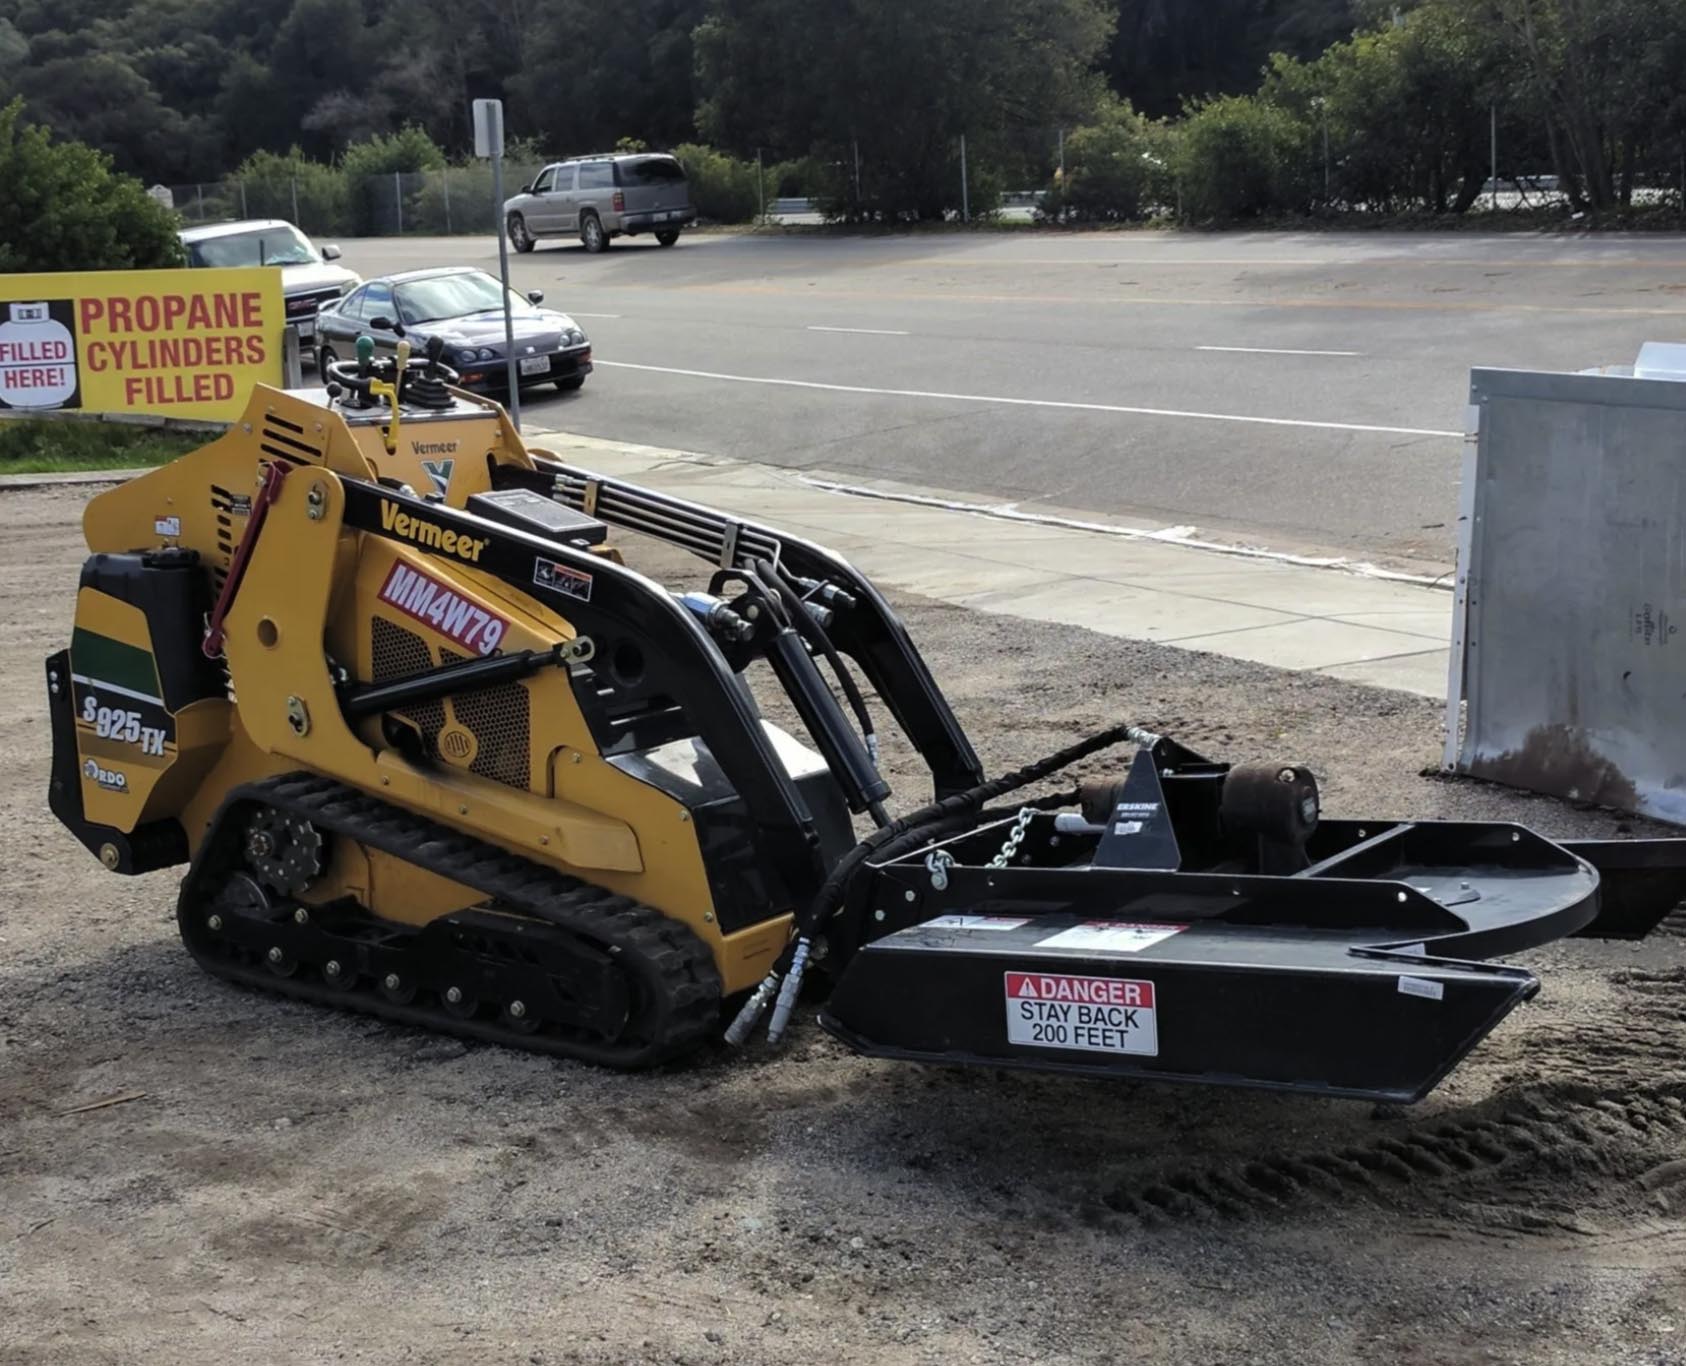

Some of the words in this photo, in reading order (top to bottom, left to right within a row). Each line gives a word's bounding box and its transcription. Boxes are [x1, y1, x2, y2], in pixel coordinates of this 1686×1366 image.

[80, 292, 264, 335] PROPANE
[0, 341, 67, 363] FILLED
[87, 335, 266, 372] CYLINDERS
[4, 368, 66, 389] HERE!
[125, 373, 234, 405] FILLED
[411, 440, 457, 455] Vermeer
[381, 499, 485, 562] Vermeer
[384, 564, 503, 656] MM4W79
[1040, 977, 1142, 1006] DANGER
[1020, 1001, 1072, 1023] STAY
[1078, 1005, 1139, 1029] BACK
[1032, 1023, 1068, 1043] 200
[1074, 1026, 1129, 1049] FEET
